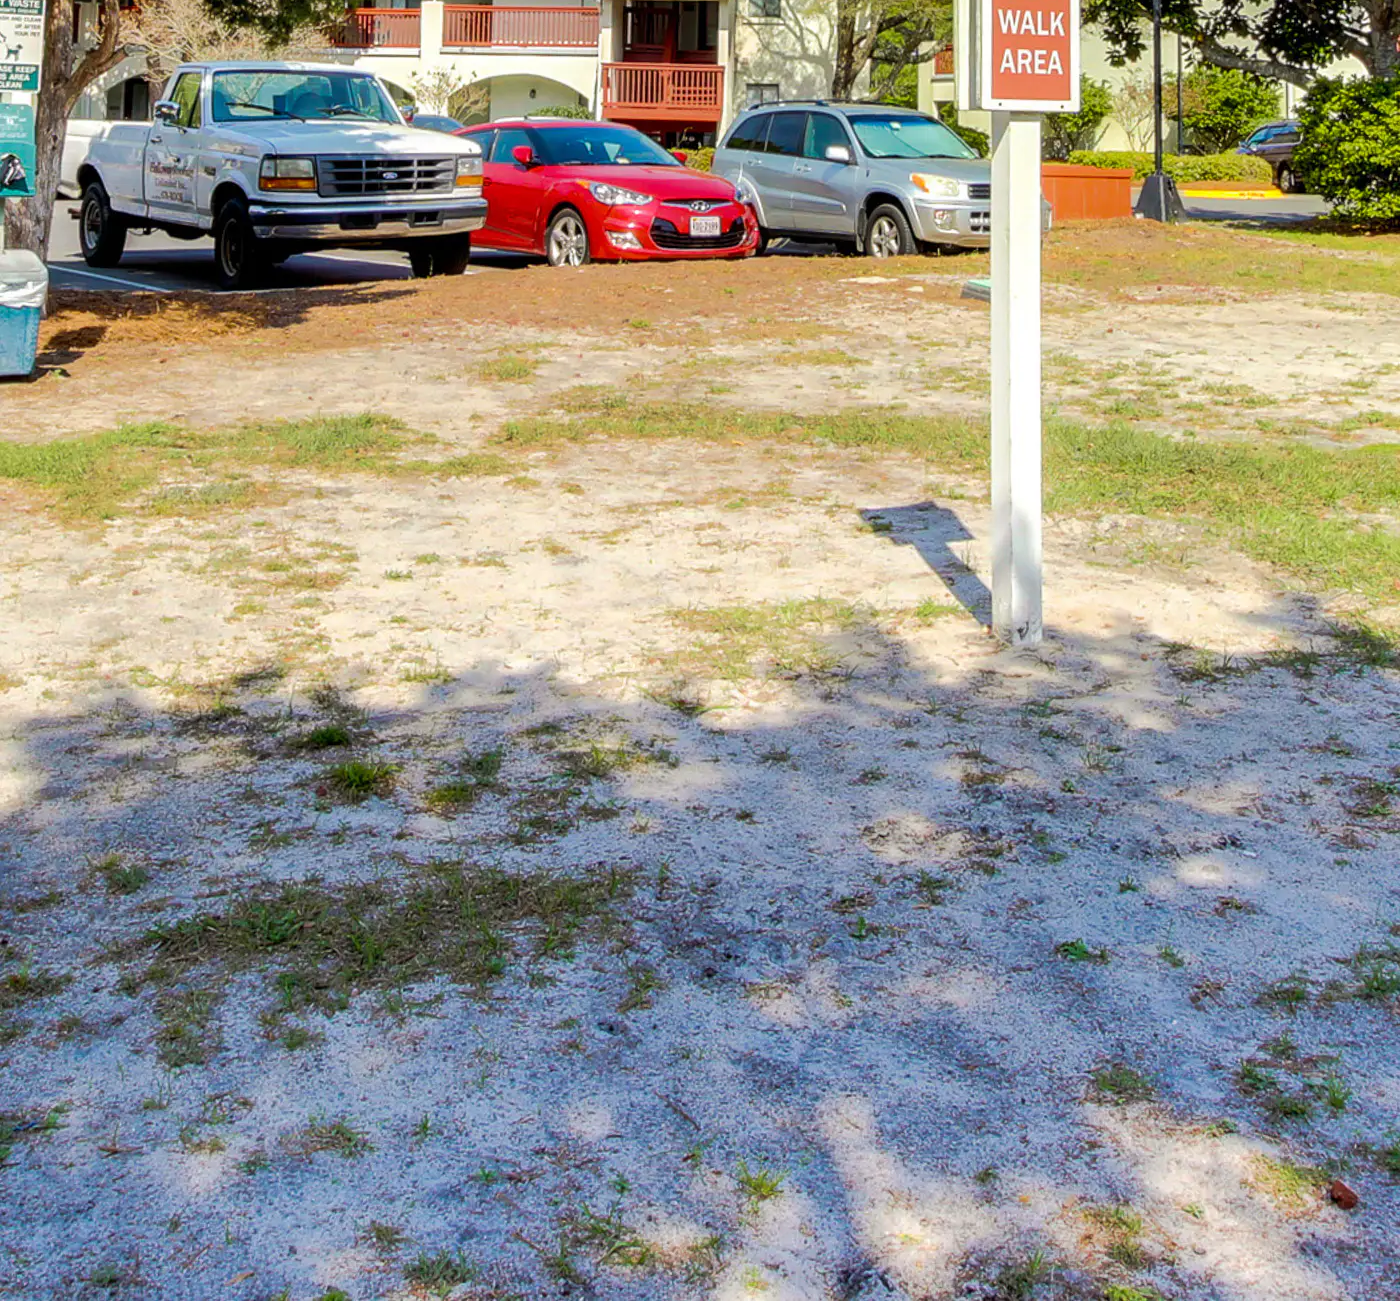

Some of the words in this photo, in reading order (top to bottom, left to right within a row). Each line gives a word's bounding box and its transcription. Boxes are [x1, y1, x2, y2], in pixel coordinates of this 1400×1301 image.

[9, 0, 41, 9] WASTE
[998, 8, 1065, 37] WALK
[999, 48, 1064, 75] AREA
[15, 66, 36, 75] KEEP
[8, 73, 30, 82] AREA
